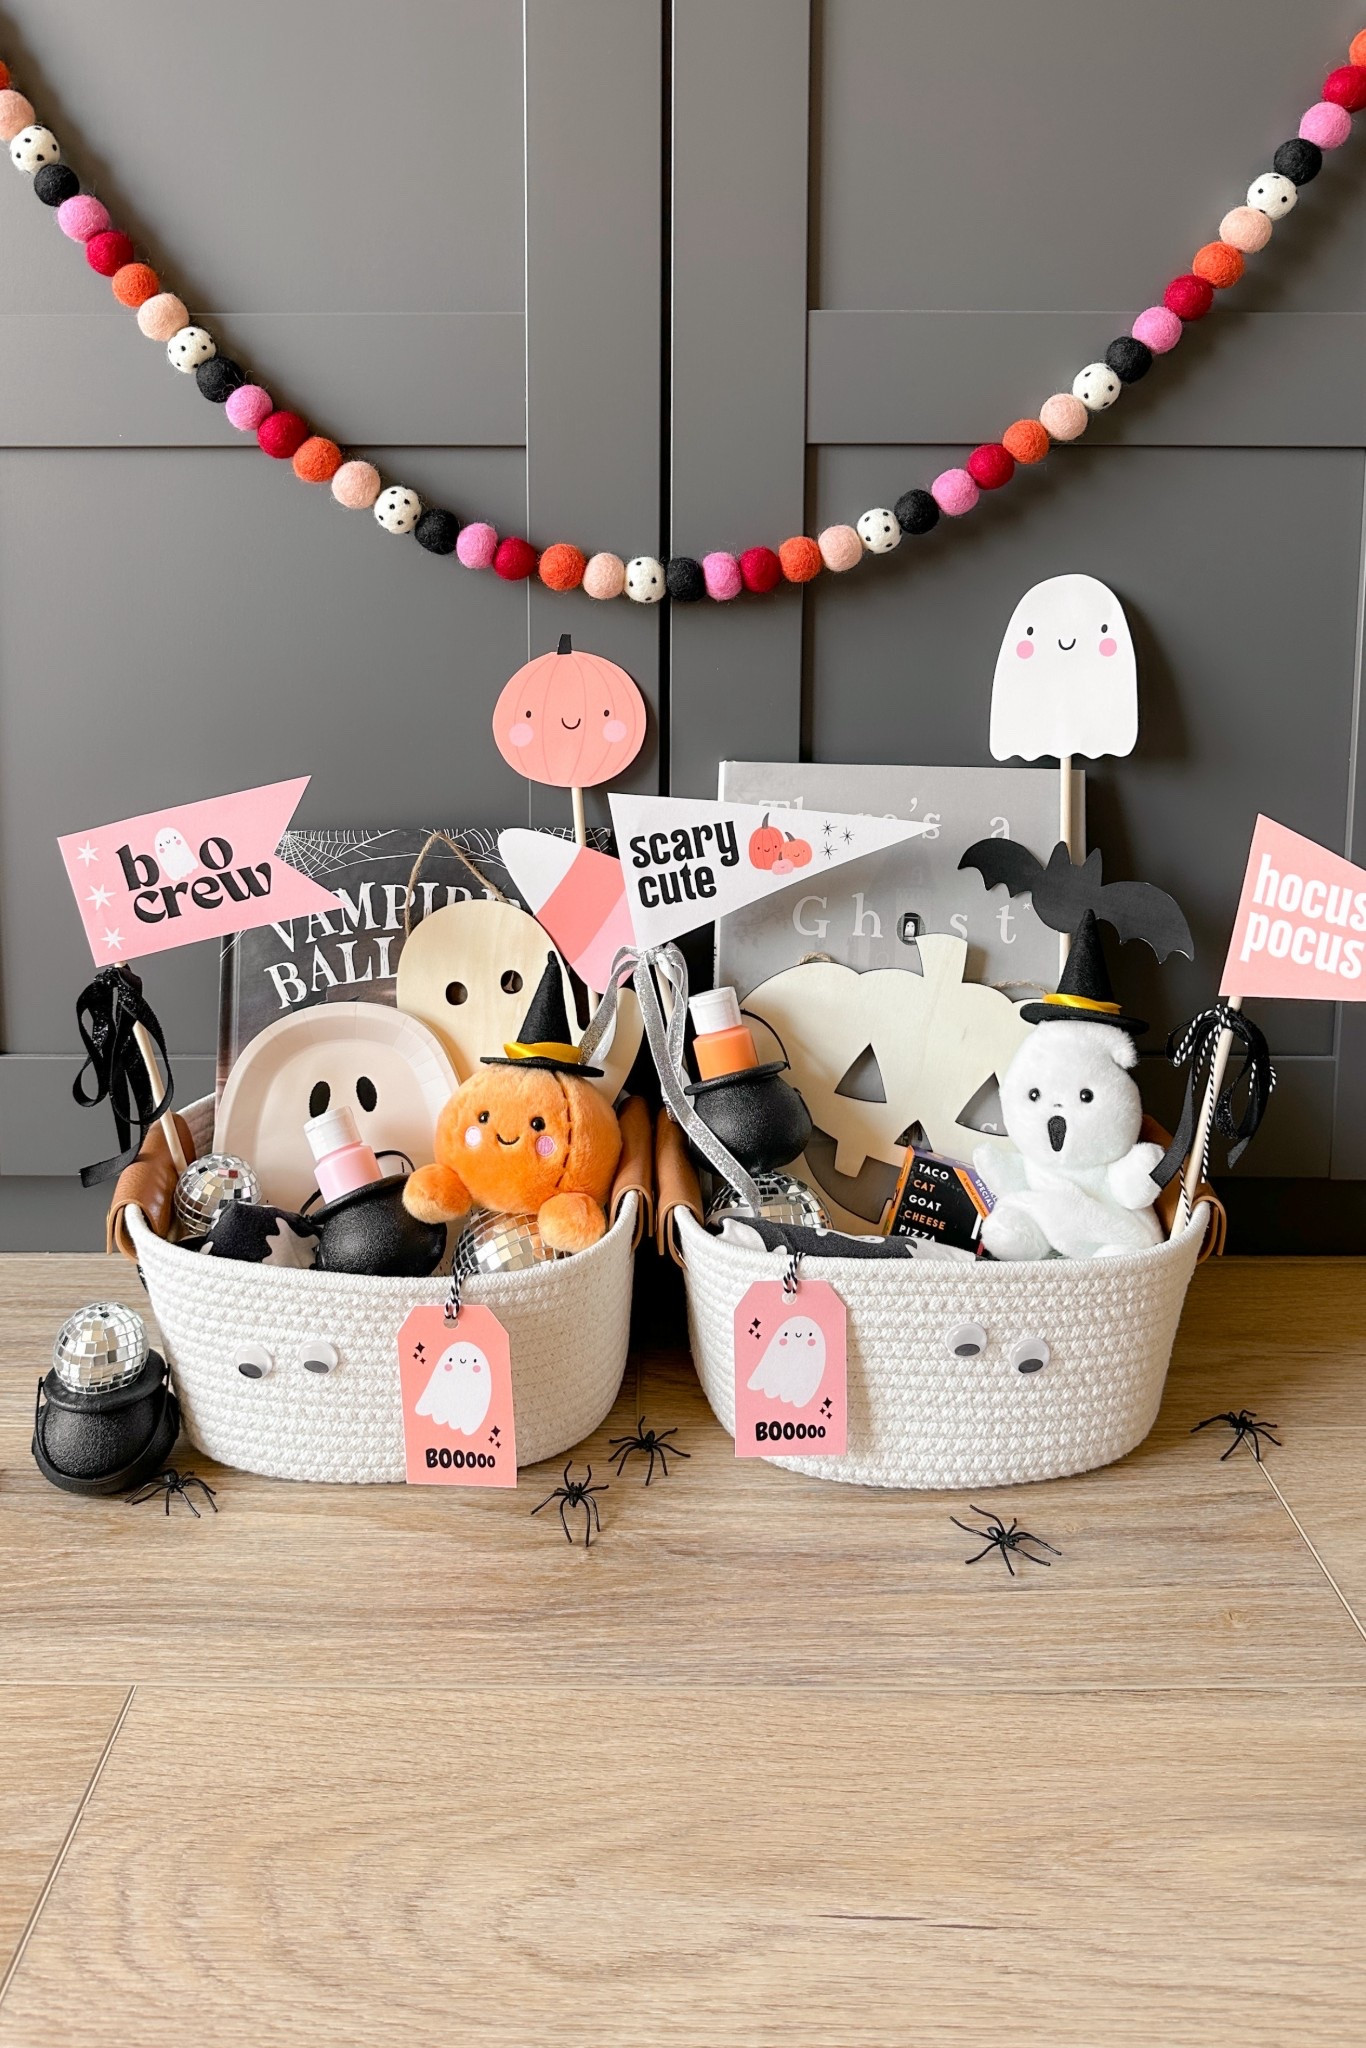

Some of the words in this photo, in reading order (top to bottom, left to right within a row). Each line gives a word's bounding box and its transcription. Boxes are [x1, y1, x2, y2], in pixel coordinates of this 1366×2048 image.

[629, 820, 740, 869] scary
[989, 816, 1010, 839] a
[133, 862, 272, 924] crew
[637, 862, 717, 908] cute
[1253, 853, 1366, 932] hocus
[268, 881, 520, 952] VAMPI
[1239, 911, 1365, 979] pocus
[913, 1179, 936, 1193] CAT
[918, 1163, 949, 1180] TACO
[908, 1194, 942, 1211] GOAT
[975, 1179, 995, 1208] SPECIAL
[904, 1210, 947, 1230] CHEESE
